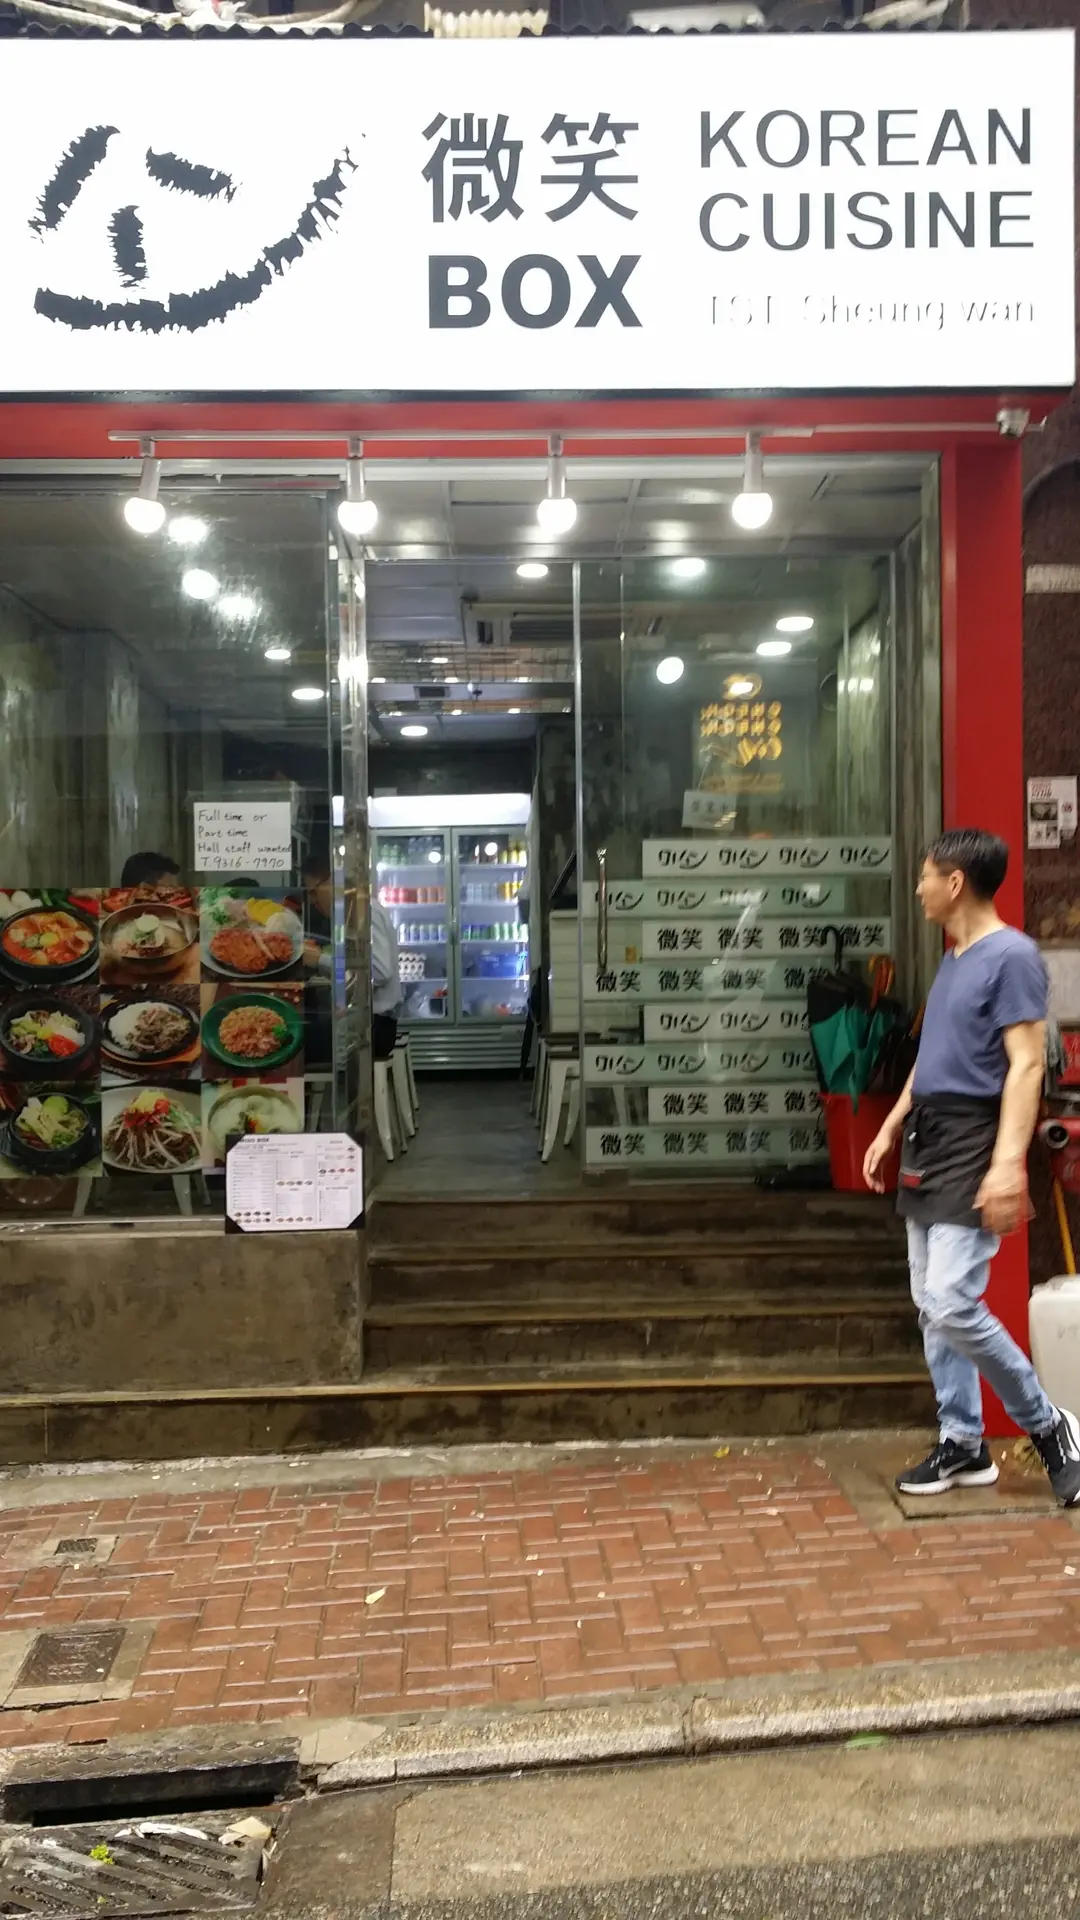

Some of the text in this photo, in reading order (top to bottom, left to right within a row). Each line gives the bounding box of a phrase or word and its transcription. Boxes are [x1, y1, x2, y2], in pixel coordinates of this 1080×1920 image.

[701, 109, 1030, 167] KOREAN
[422, 113, 638, 222] 微笑
[700, 192, 1033, 251] CUISINE
[429, 254, 642, 328] BOX
[961, 301, 1034, 322] wan
[198, 809, 220, 822] Full
[224, 812, 243, 822] time
[198, 825, 248, 838] Part time
[198, 841, 220, 853] Hall
[258, 843, 292, 853] wanted
[657, 927, 702, 951] 微笑
[595, 969, 641, 993] 微笑
[658, 969, 703, 993] 微笑
[663, 1091, 709, 1116] 微笑
[723, 1090, 769, 1115] 微笑
[600, 1132, 645, 1156] 微笑
[663, 1131, 709, 1155] 微笑
